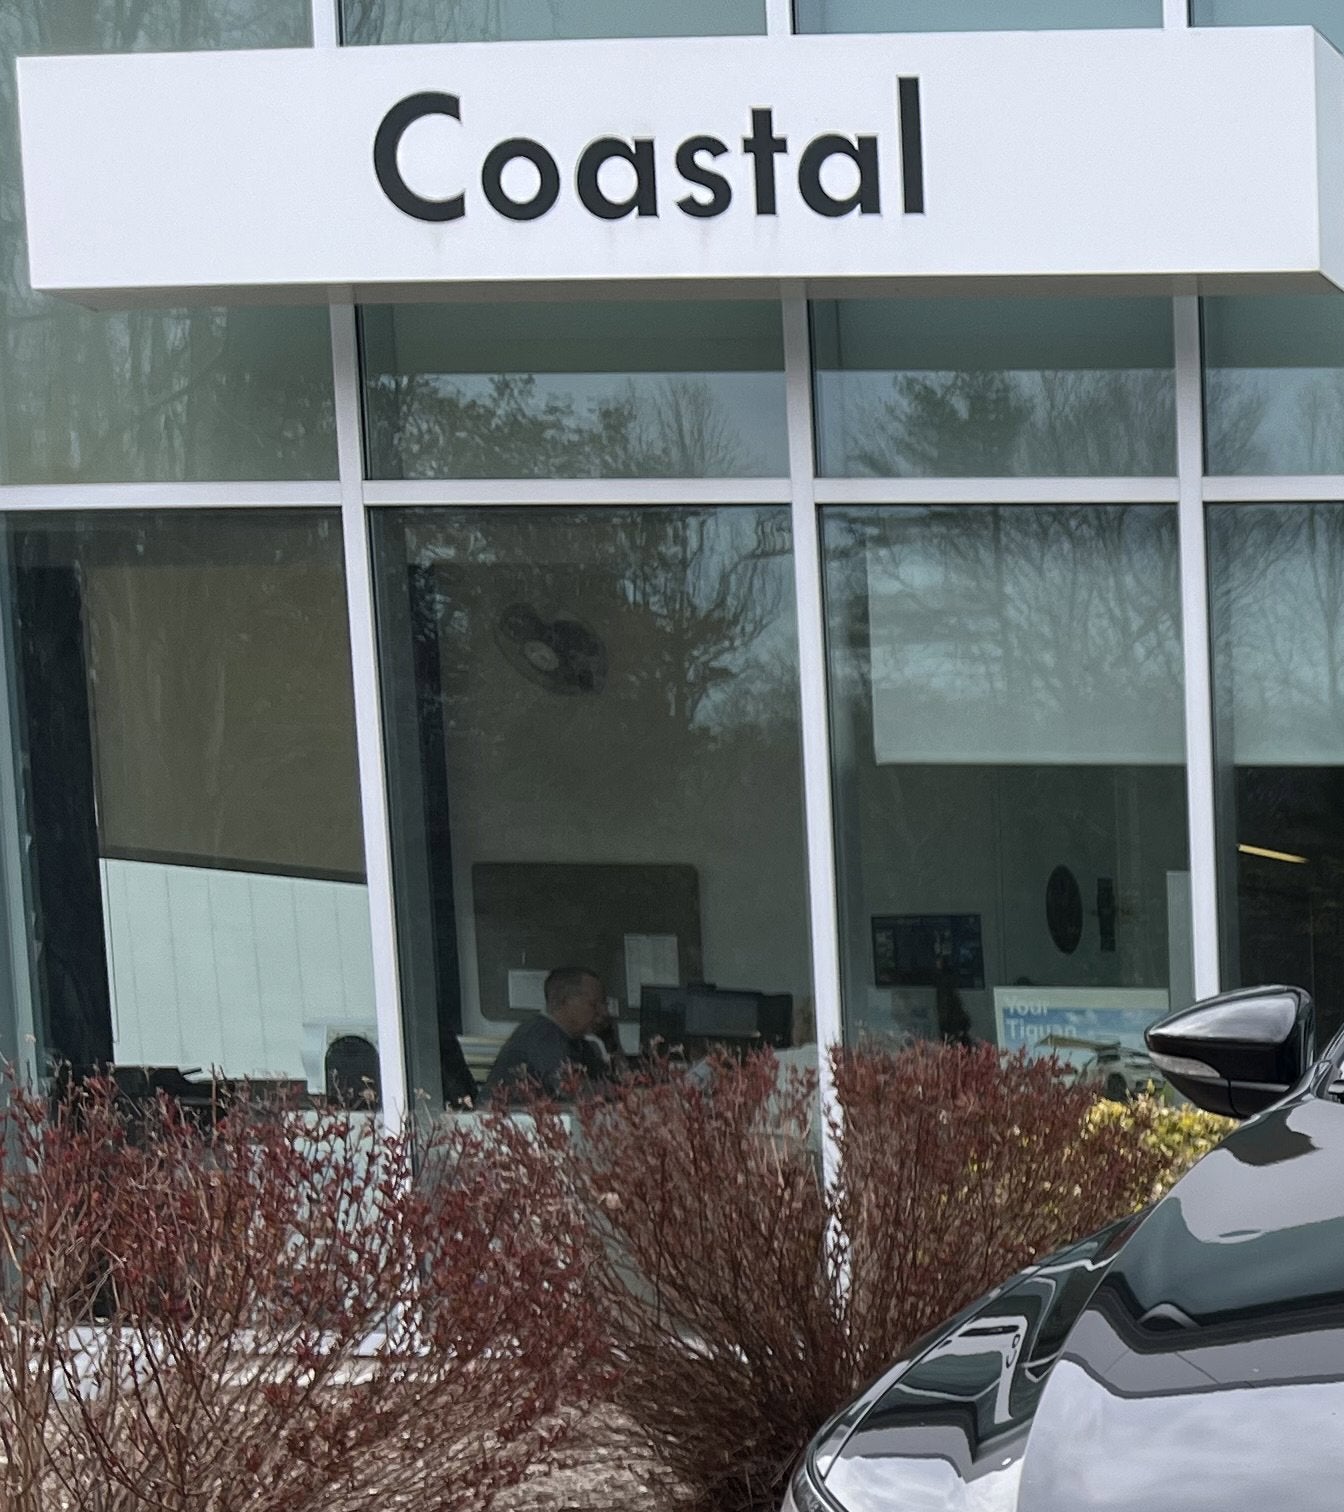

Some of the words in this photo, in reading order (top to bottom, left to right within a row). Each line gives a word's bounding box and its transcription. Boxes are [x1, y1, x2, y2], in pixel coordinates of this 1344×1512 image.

[372, 75, 928, 223] Coastal
[1004, 996, 1049, 1016] Your
[1006, 1018, 1077, 1042] Tiguan
